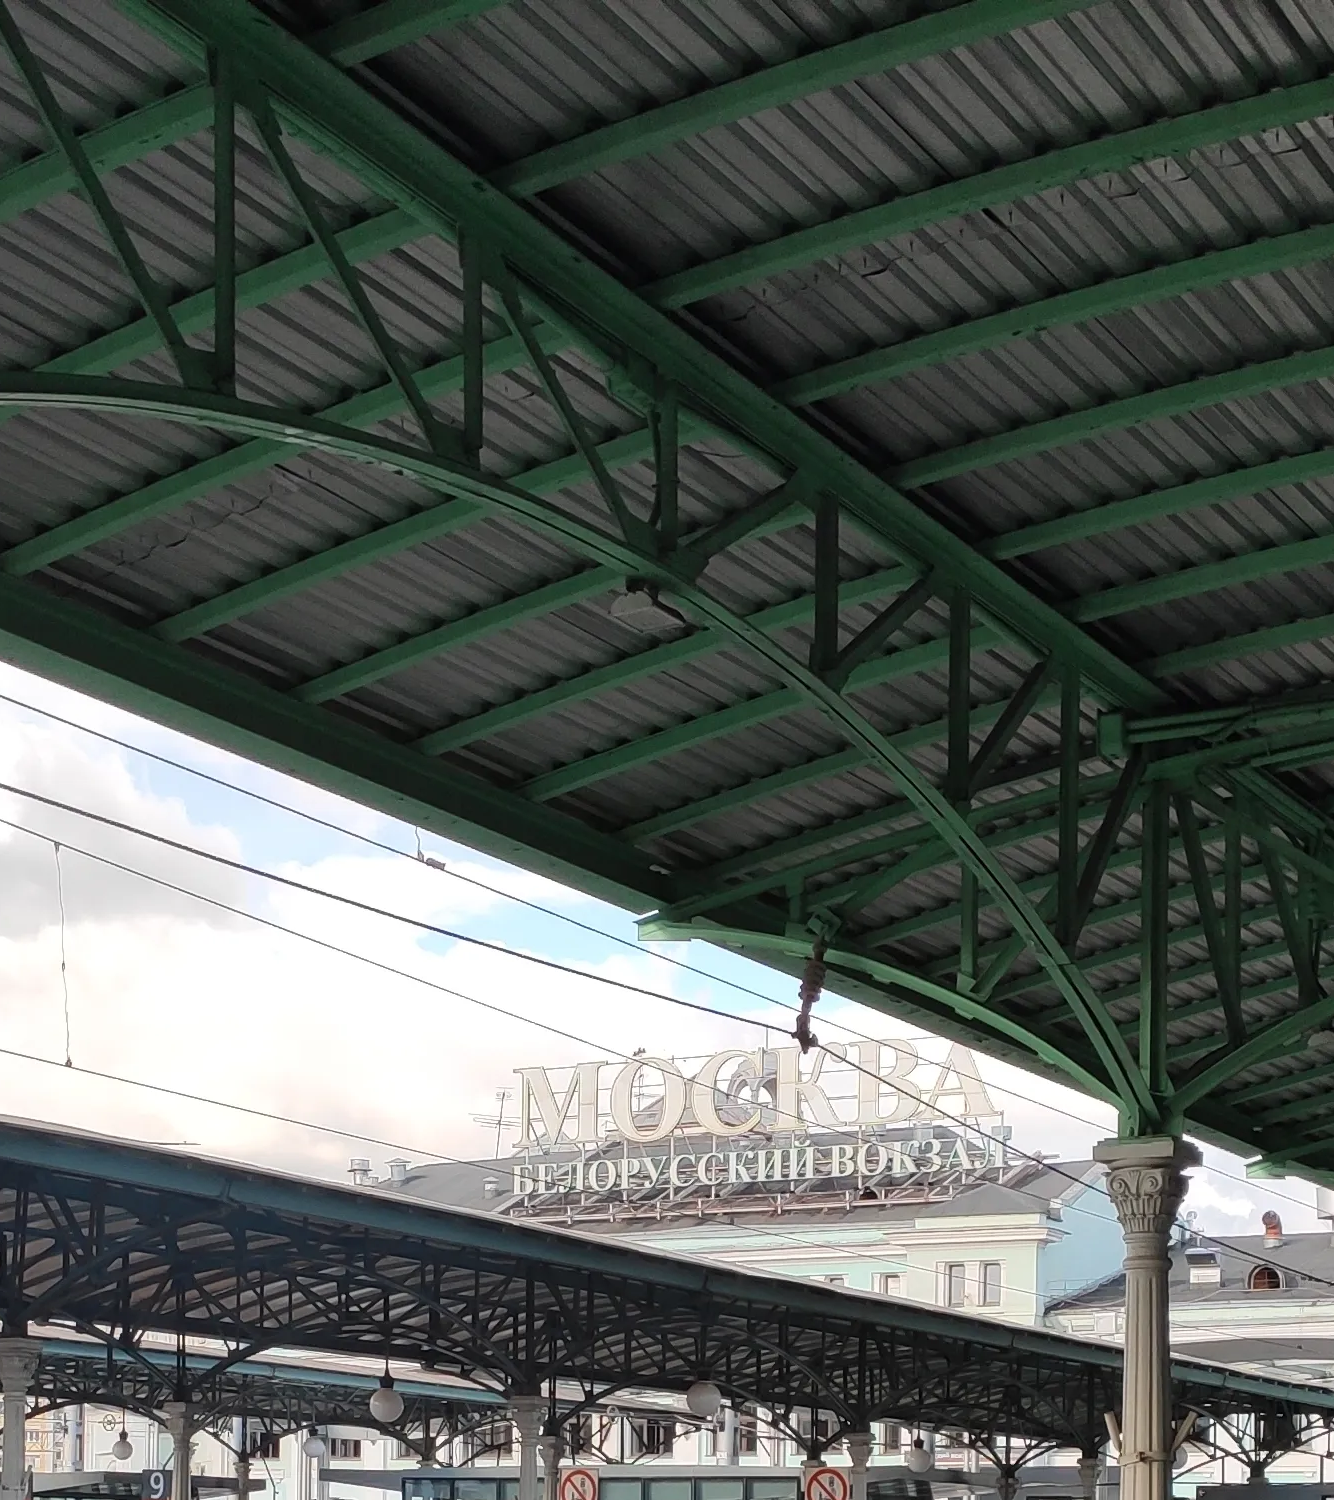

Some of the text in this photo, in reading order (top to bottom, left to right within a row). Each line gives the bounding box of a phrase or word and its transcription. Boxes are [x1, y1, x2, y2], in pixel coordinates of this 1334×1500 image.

[513, 1038, 1003, 1149] МОСКВА
[512, 1133, 1008, 1197] БЕЛОРУССКИЙ ВОКЗАЛ
[150, 1471, 164, 1499] 9
